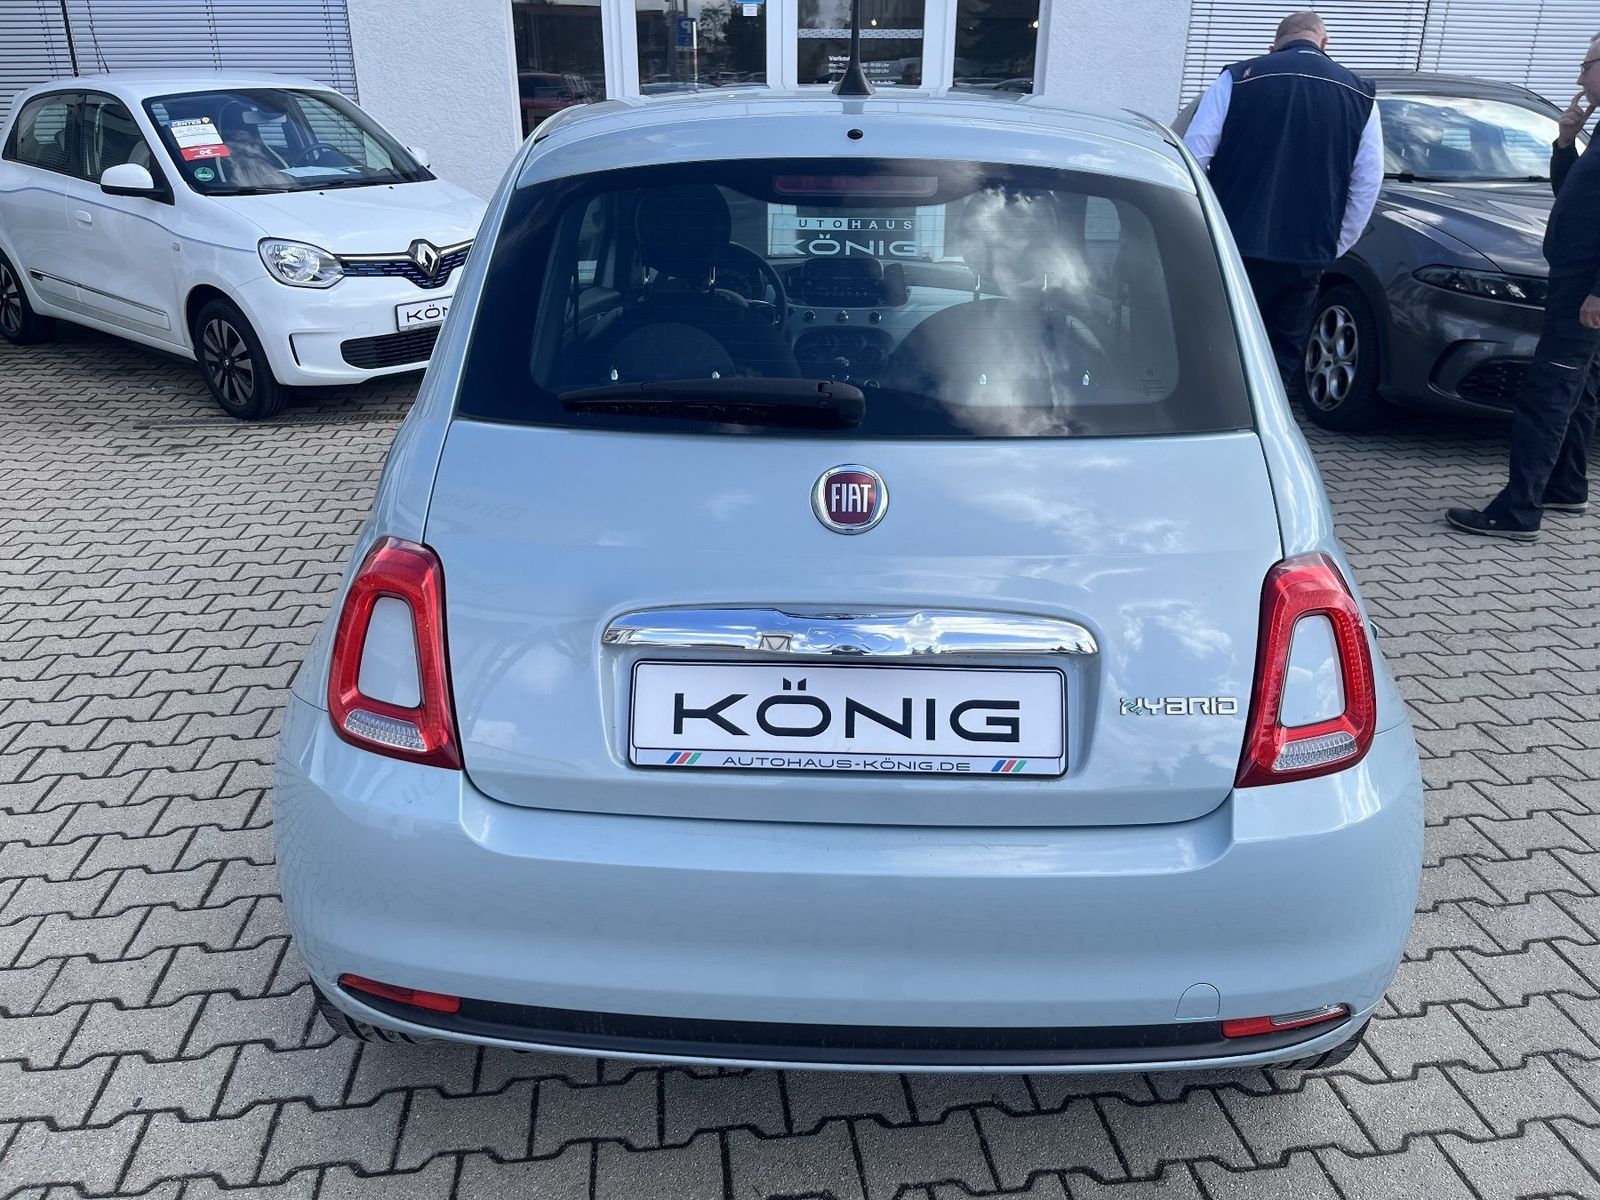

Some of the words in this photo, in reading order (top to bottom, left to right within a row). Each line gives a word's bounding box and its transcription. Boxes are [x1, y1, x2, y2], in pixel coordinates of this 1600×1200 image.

[782, 219, 913, 230] AUTOHAUS
[406, 303, 449, 323] KÖN
[831, 483, 872, 513] FIAT
[673, 677, 1020, 743] KÖNIG
[1120, 697, 1239, 715] HYBRID
[722, 756, 971, 772] AUTOHAUS-KÖNIG.DE
